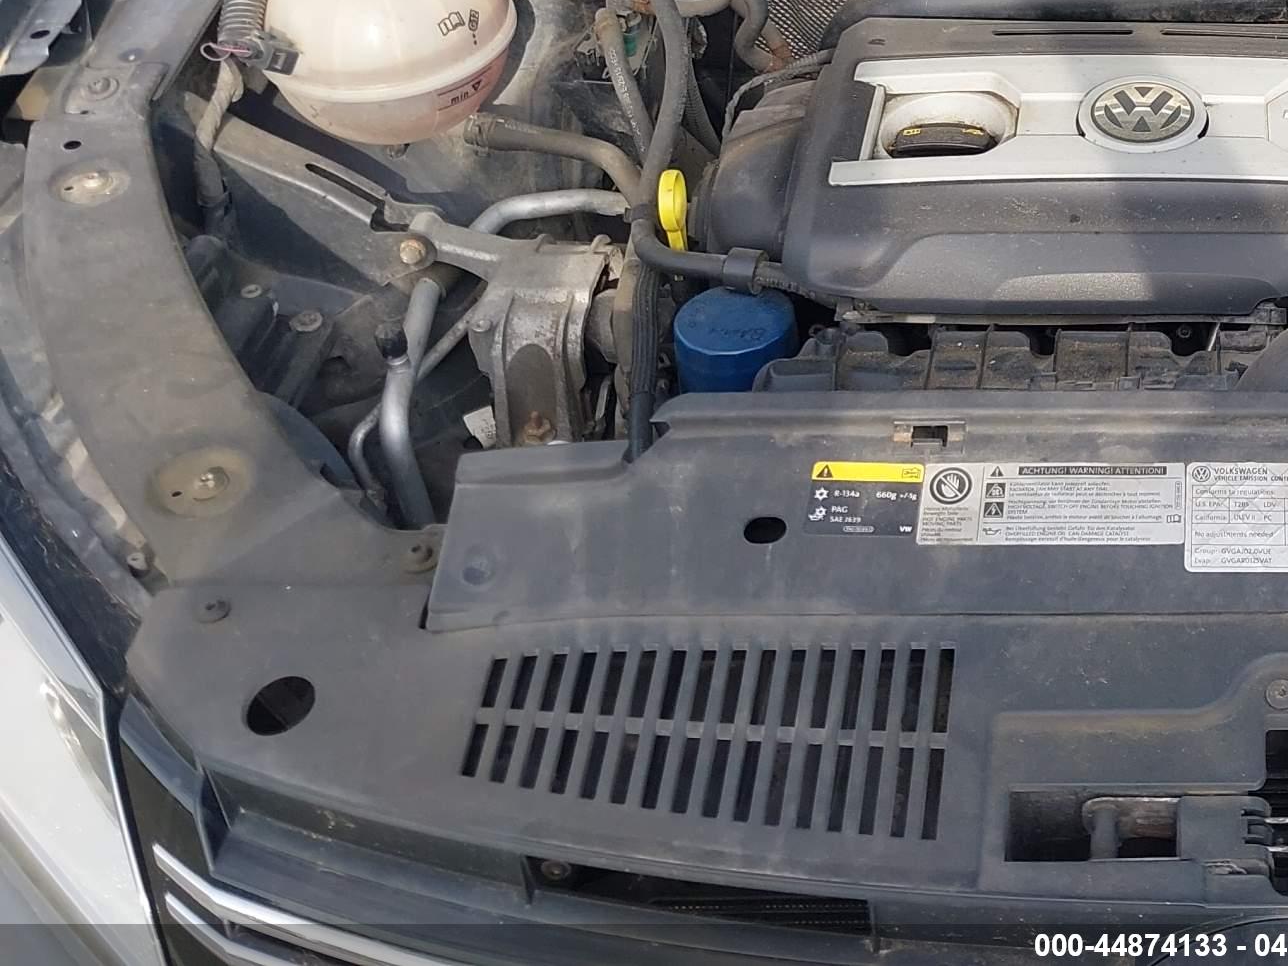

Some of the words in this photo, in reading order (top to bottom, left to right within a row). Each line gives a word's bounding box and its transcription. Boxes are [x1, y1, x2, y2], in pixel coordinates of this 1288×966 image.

[450, 92, 469, 105] min
[1022, 467, 1068, 475] ACHTUNG!
[1069, 467, 1113, 475] WARNING!
[1214, 467, 1268, 475] VOLKSWAGEN
[876, 491, 897, 501] 660g
